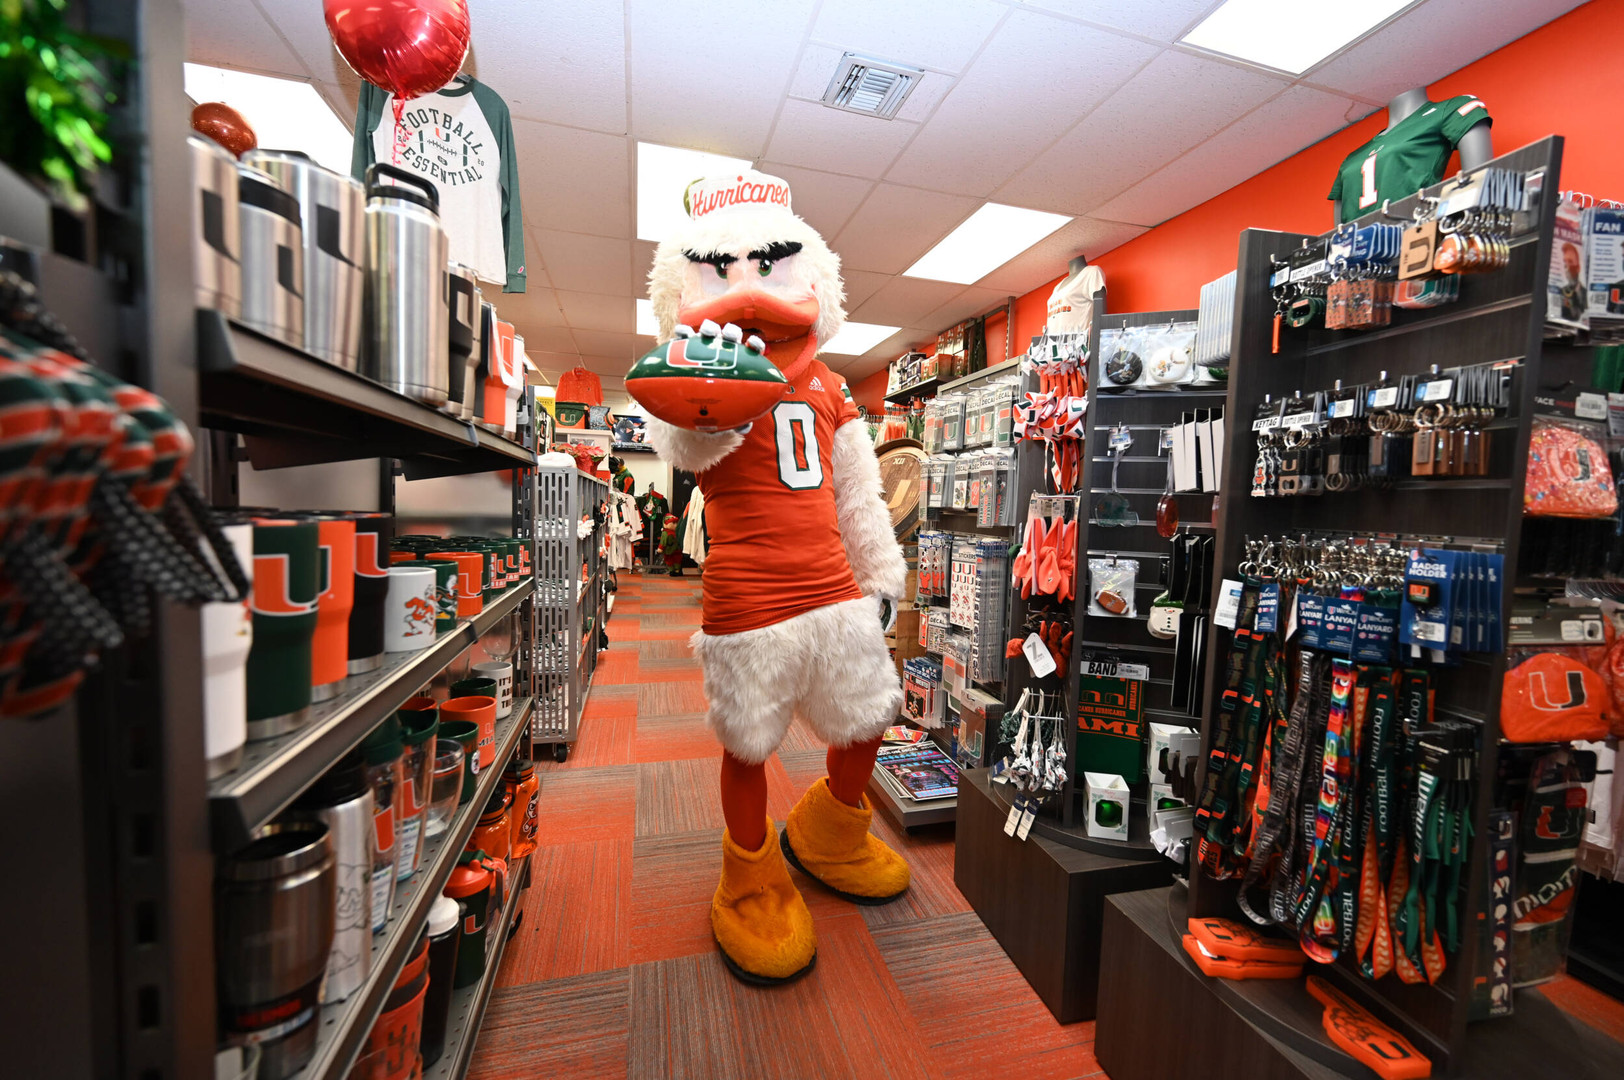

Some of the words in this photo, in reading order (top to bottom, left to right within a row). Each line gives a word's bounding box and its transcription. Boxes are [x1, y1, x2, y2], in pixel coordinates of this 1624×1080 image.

[399, 108, 483, 155] FOOTBALL
[402, 146, 483, 186] ESSENTIAL
[1359, 153, 1378, 209] 1
[692, 174, 789, 220] Hurricanes
[1595, 222, 1621, 233] FAN
[1253, 417, 1280, 431] KEYTAG
[1408, 567, 1448, 579] HOLDER
[1411, 562, 1447, 573] BADGE
[1357, 622, 1394, 634] LANYARD
[1087, 662, 1118, 676] BAND
